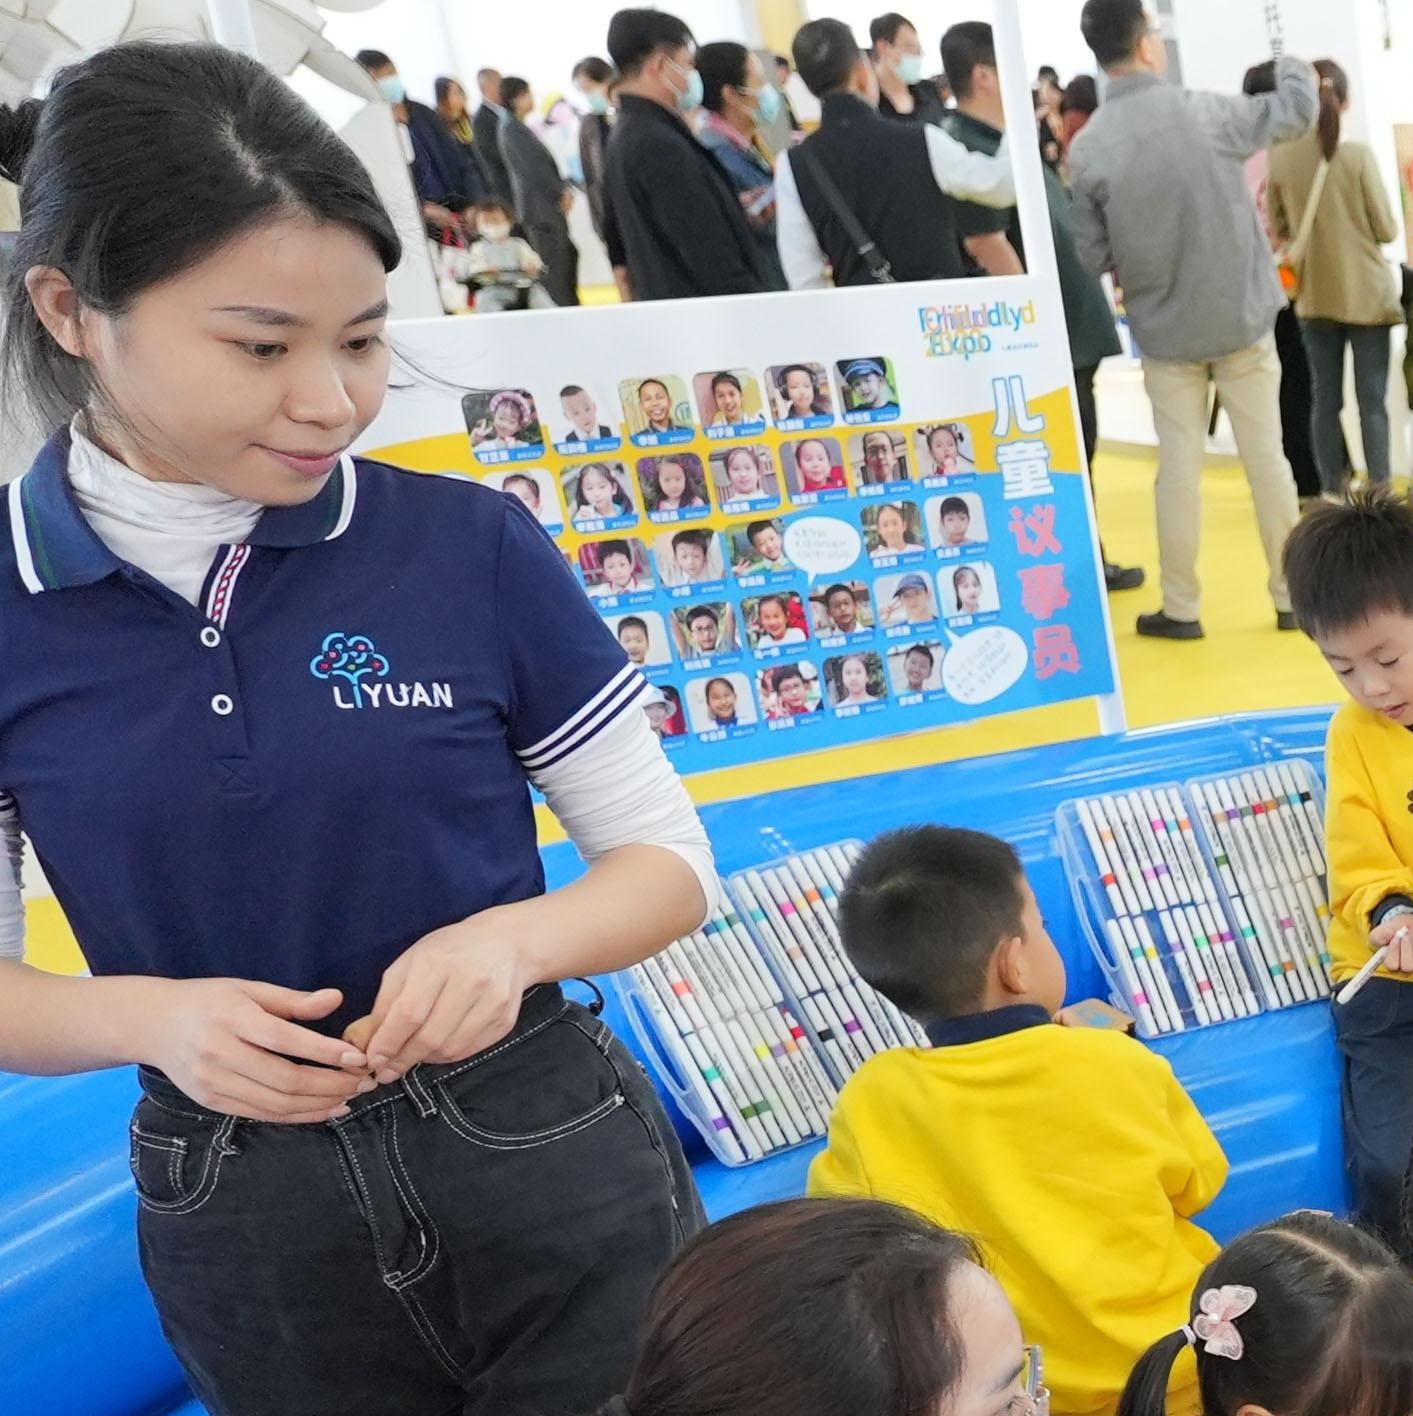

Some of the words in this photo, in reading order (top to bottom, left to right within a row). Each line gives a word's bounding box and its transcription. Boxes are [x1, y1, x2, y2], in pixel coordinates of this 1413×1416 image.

[990, 374, 1082, 681] 儿童议事员
[332, 682, 455, 710] LIYUAN
